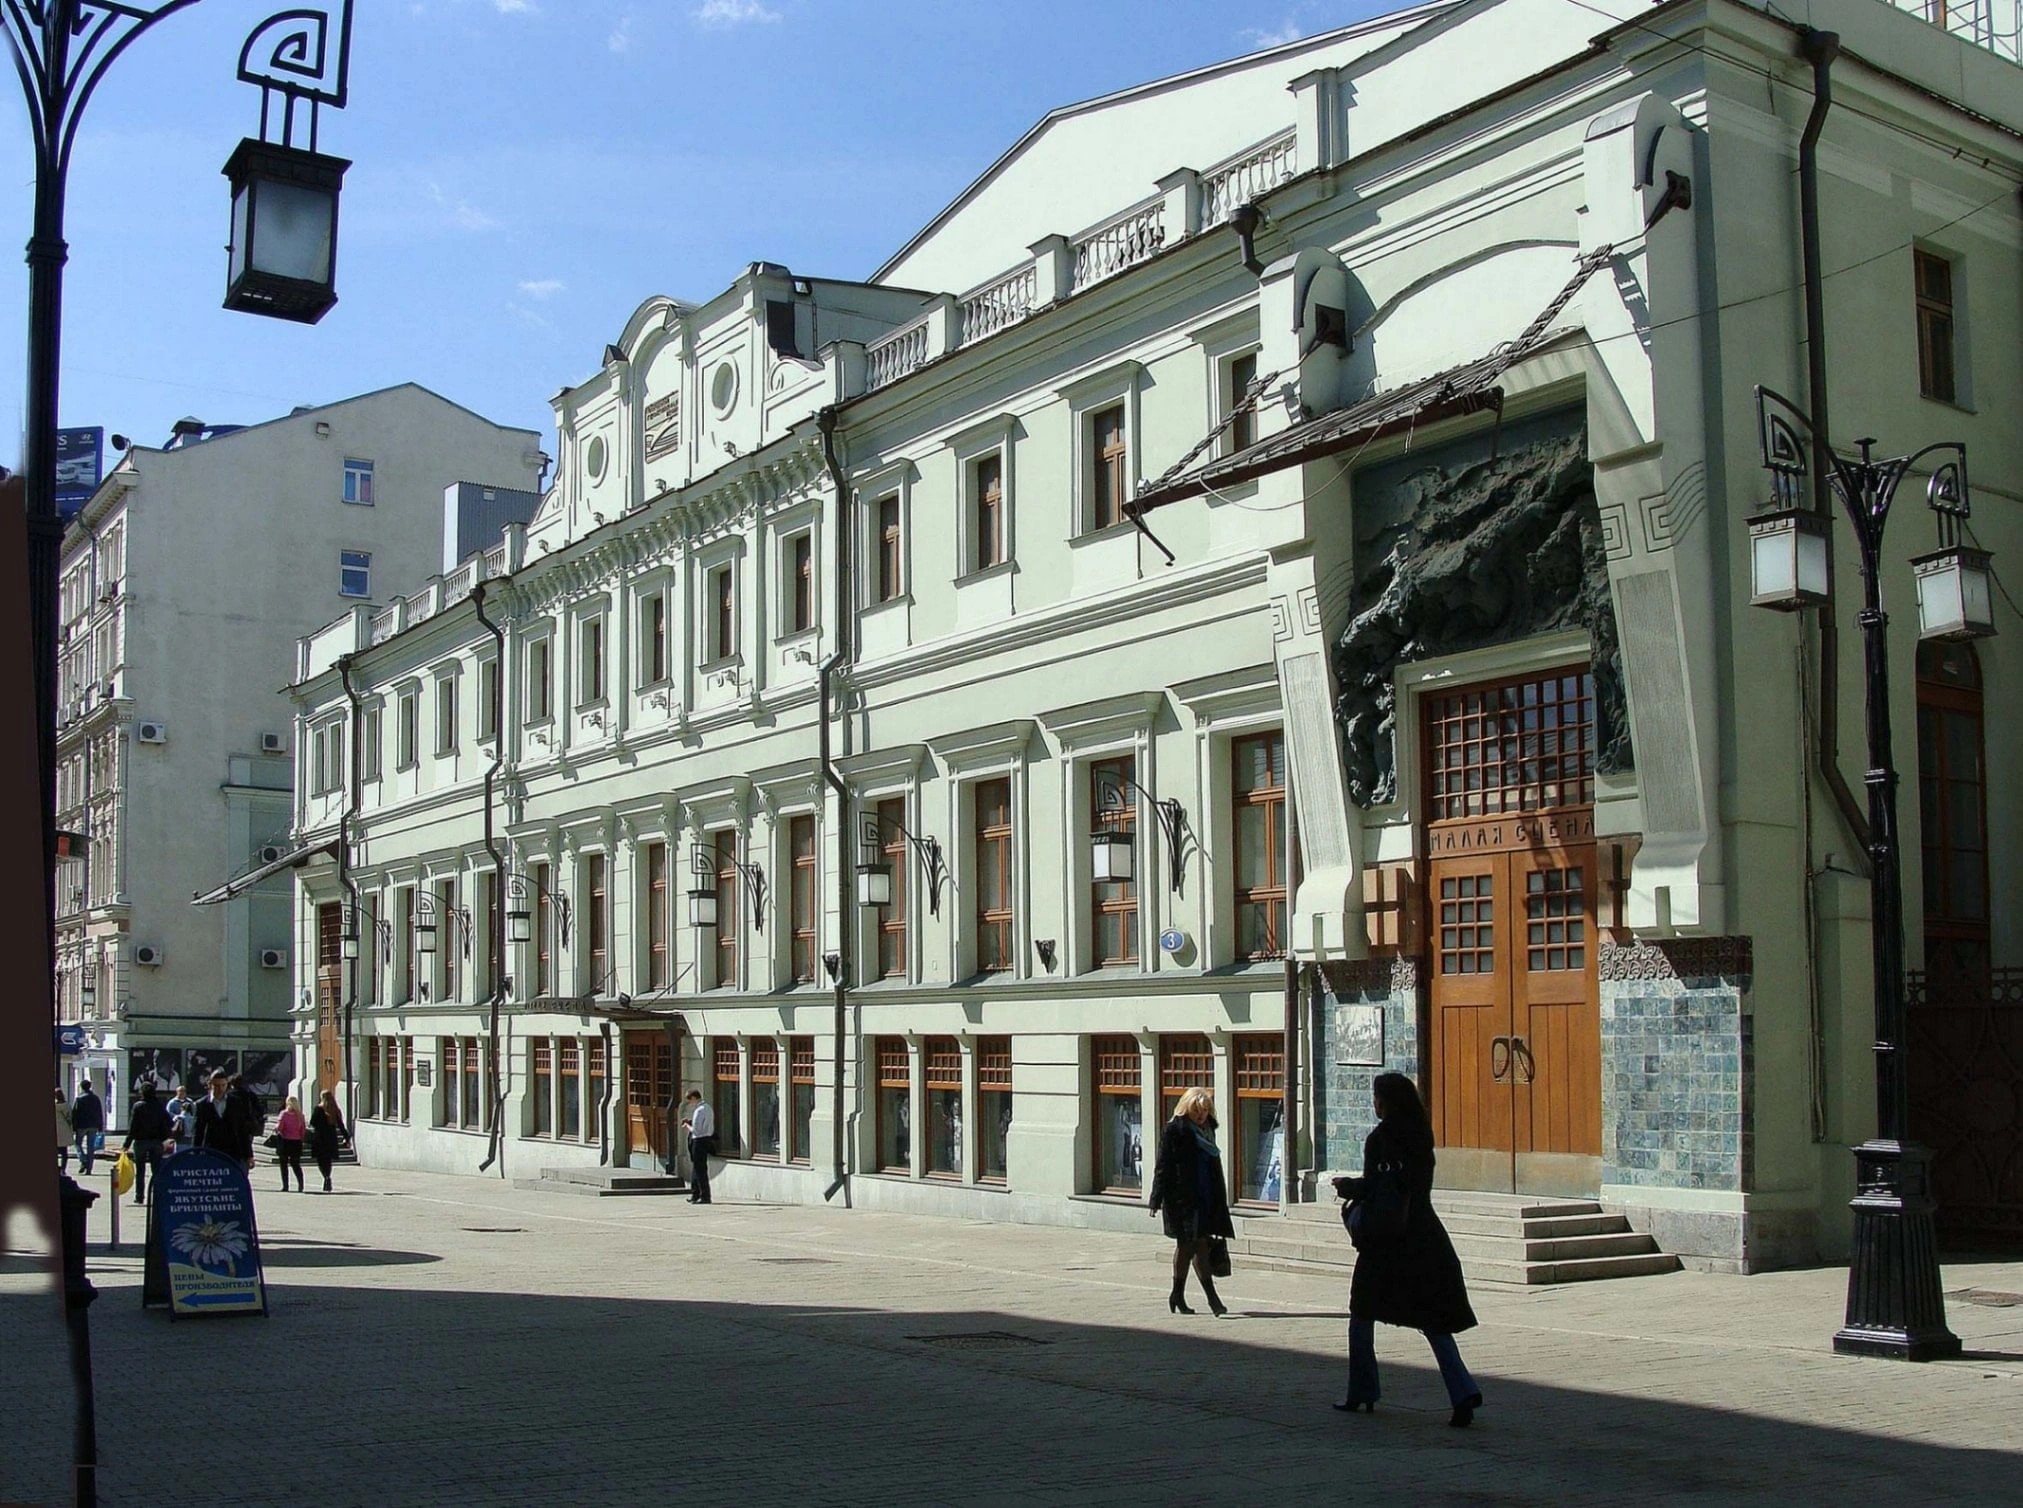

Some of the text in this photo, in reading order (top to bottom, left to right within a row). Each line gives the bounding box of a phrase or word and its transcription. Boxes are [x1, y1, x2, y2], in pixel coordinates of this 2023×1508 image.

[1430, 816, 1594, 851] МАЛАЯ СЦЕНА
[1167, 933, 1175, 948] 3
[173, 1168, 230, 1177] КРИСТАЛЛ
[183, 1178, 222, 1187] МЕЧТЫ
[174, 1194, 236, 1203] ЯКУТСКИЕ
[170, 1203, 242, 1213] БРИЛЛИАНТЫ
[174, 1273, 204, 1281] ЦЕНЫ
[174, 1281, 255, 1291] ПРОИЗВОДИТЕЛЯ
